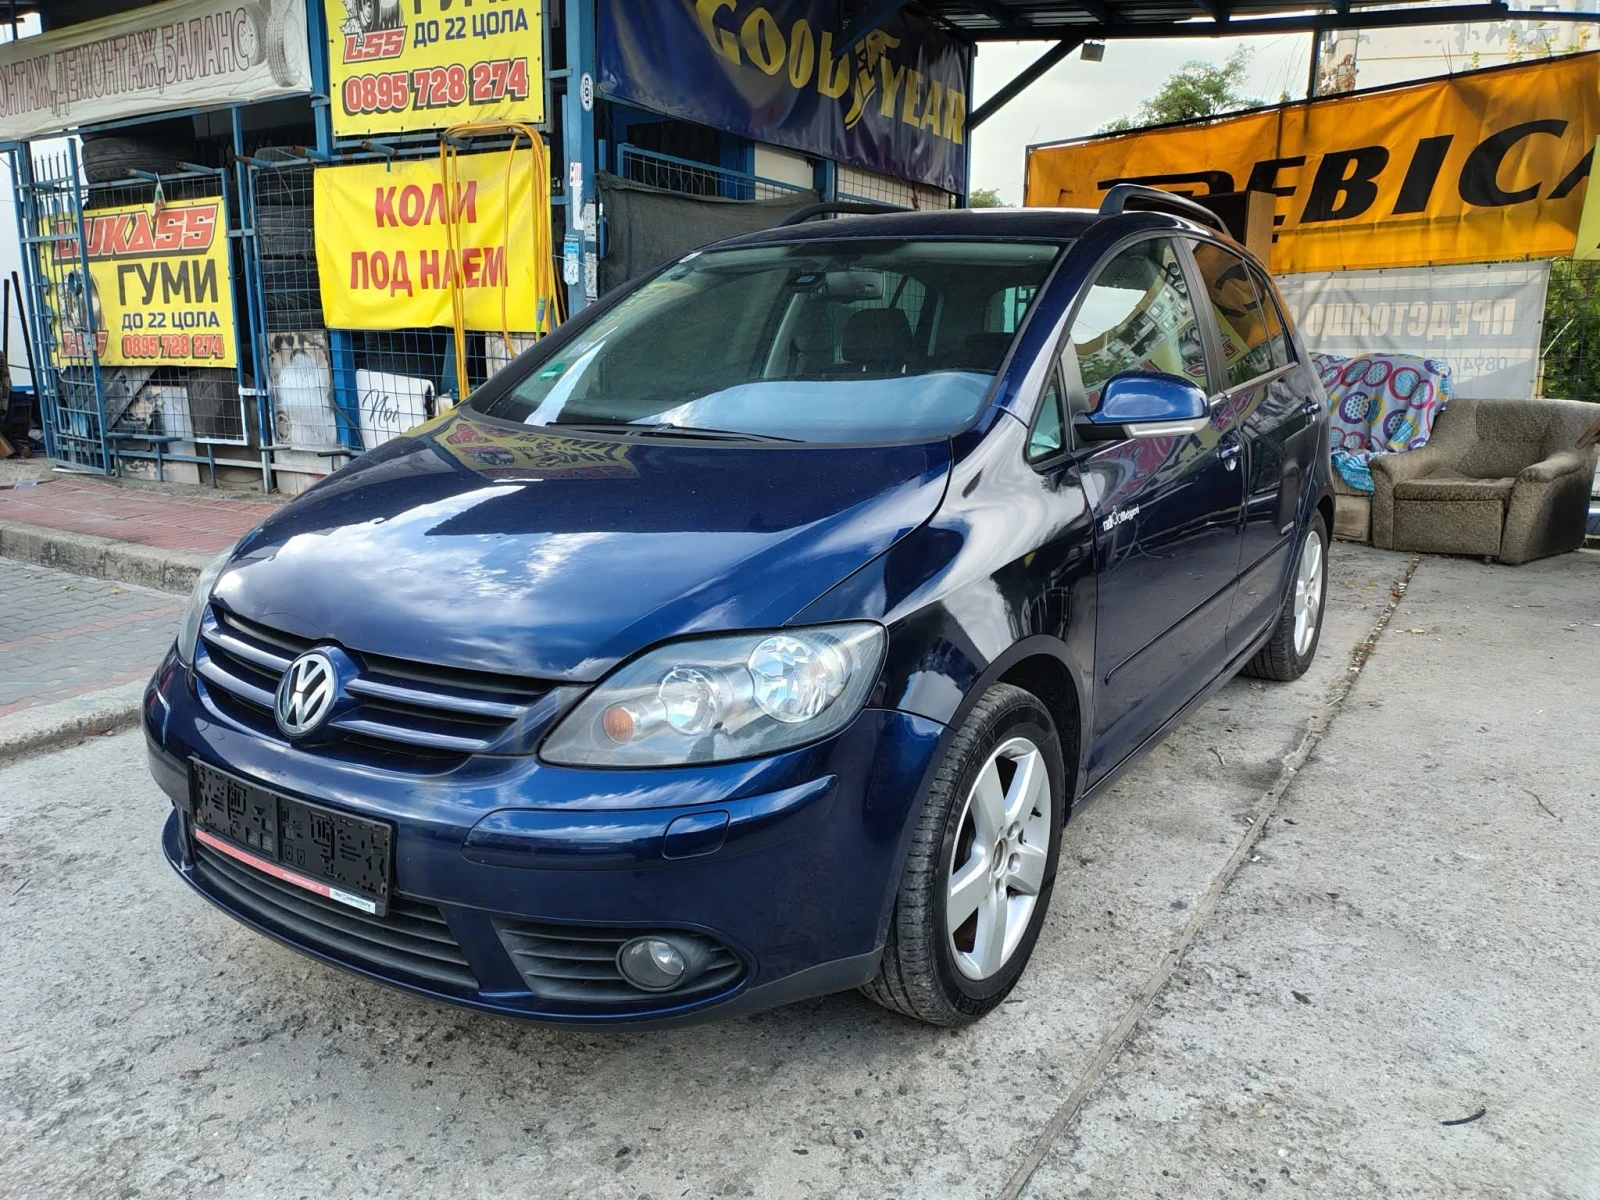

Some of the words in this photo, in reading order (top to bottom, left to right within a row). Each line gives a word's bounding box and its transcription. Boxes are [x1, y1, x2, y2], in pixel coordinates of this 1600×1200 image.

[344, 27, 408, 63] LSS
[413, 19, 440, 49] ДО
[444, 16, 467, 41] 22
[471, 7, 529, 40] ЦОЛА
[343, 72, 410, 114] 0895
[413, 64, 467, 108] 728
[471, 57, 530, 103] 274
[374, 180, 478, 228] КОЛИ
[117, 258, 219, 306] ГУМИ
[349, 250, 414, 298] ПОД
[419, 245, 509, 290] НАЕМ
[121, 312, 144, 332] ДО
[147, 312, 167, 329] 22
[171, 310, 221, 331] ЦОЛА
[122, 333, 161, 359] 0895
[160, 332, 191, 359] 728
[192, 333, 225, 359] 274
